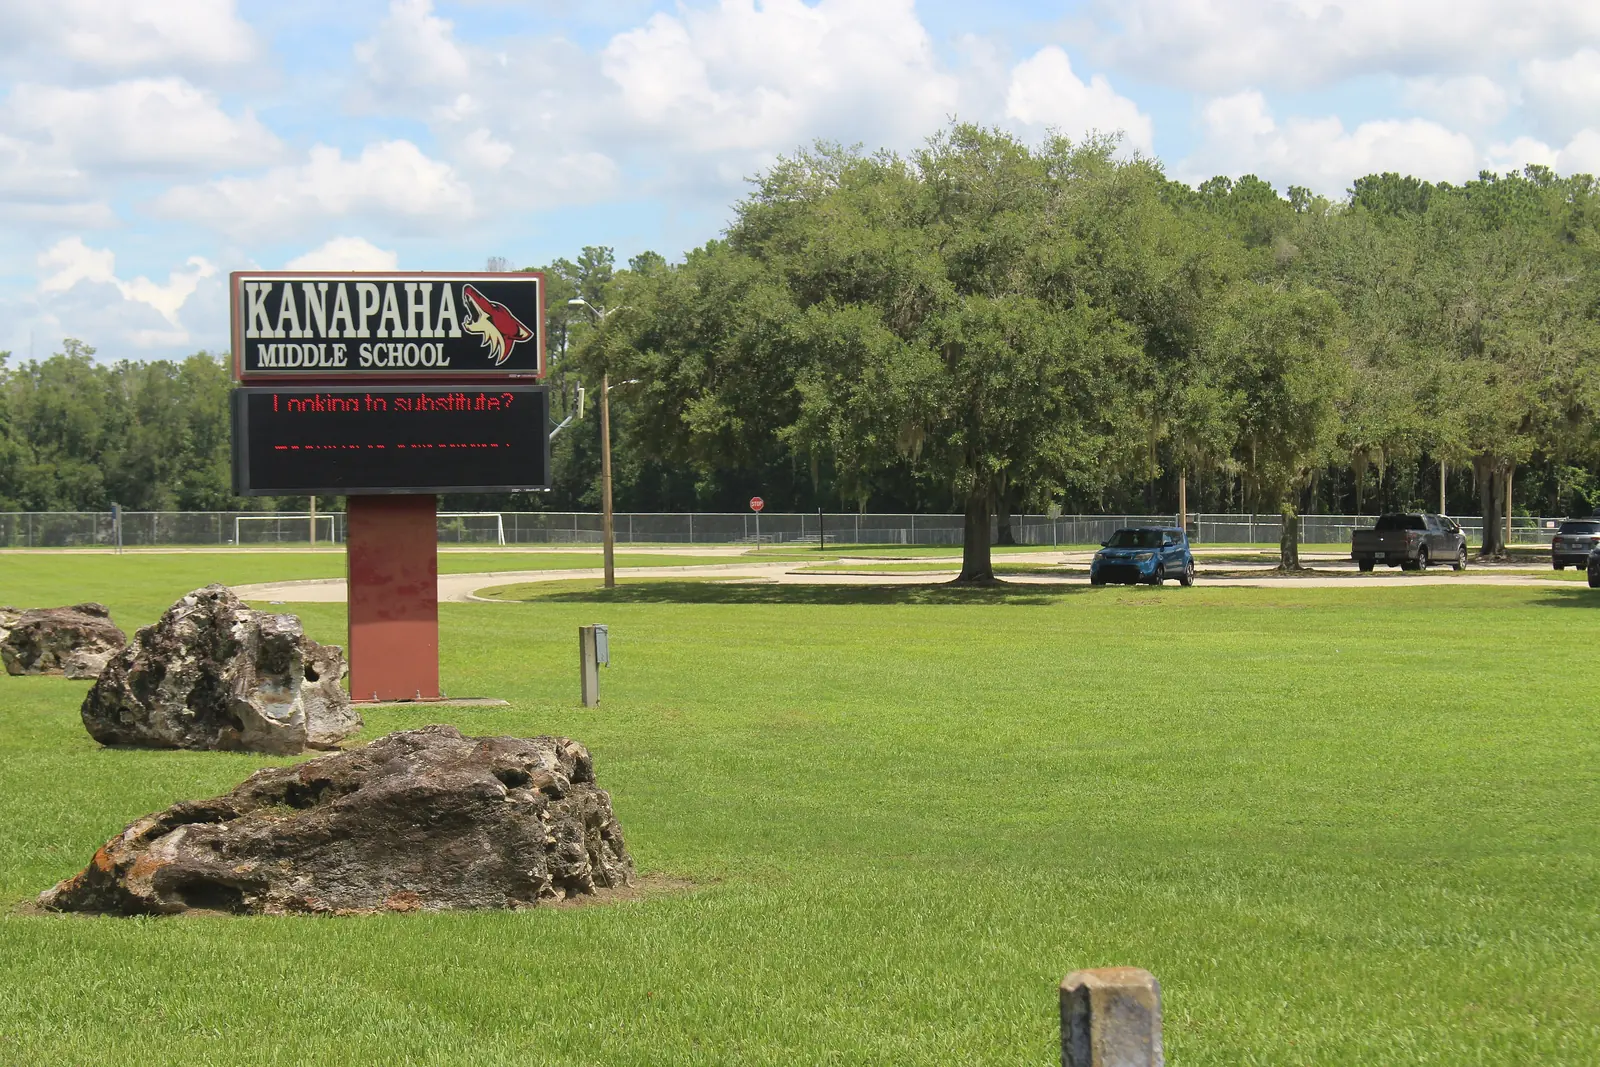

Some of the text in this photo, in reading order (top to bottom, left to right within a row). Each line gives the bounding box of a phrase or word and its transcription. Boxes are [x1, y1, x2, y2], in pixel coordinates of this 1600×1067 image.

[245, 282, 463, 339] KANAPAHA
[257, 343, 451, 368] MIDDLE SCHOOL
